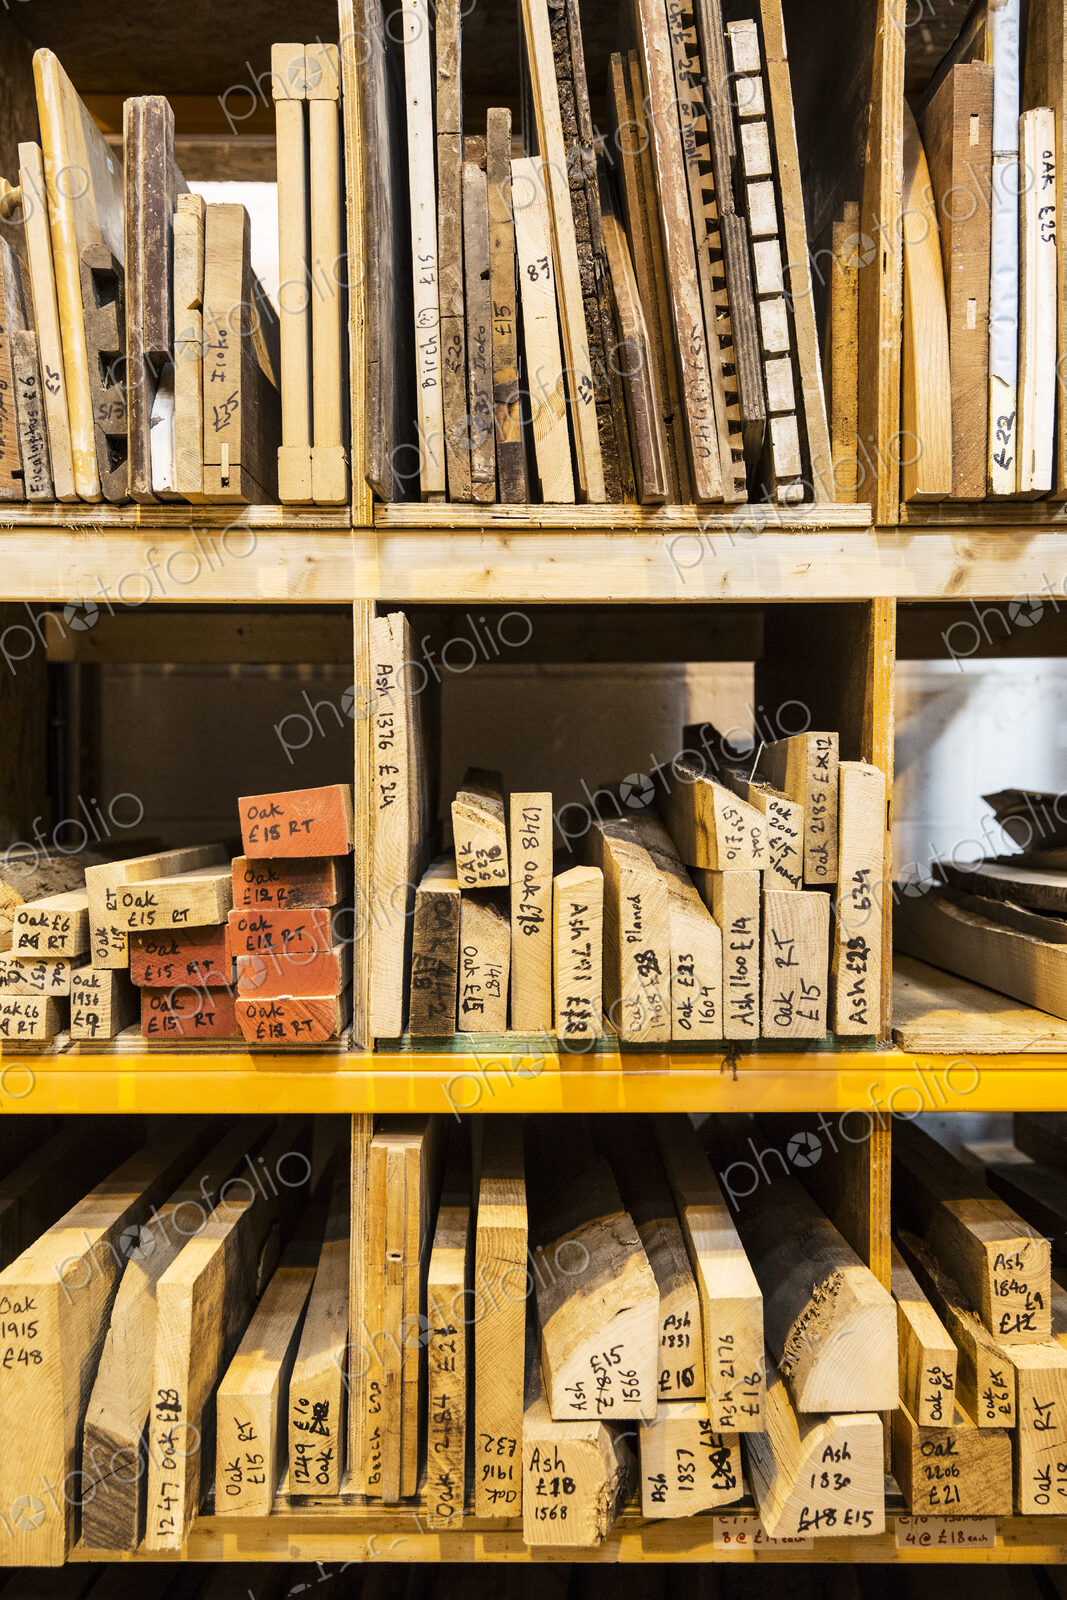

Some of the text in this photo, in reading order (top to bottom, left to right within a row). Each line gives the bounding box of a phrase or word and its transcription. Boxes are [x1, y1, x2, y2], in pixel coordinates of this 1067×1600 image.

[1042, 150, 1055, 190] OAK
[493, 304, 512, 336] £15
[421, 334, 437, 389] Birch
[376, 663, 395, 697] Ash
[377, 712, 395, 750] 1376
[248, 803, 284, 820] Oak
[289, 819, 315, 835] RT
[519, 807, 542, 850] 1248
[810, 793, 828, 876] Oak 2185
[750, 827, 764, 858] Oak
[244, 870, 280, 884] Oak
[522, 861, 542, 902] Oak
[106, 888, 117, 910] RT
[122, 891, 158, 908] Oak
[18, 912, 70, 931] Oak £6
[128, 909, 190, 927] £15 RT
[238, 916, 273, 932] Oak
[570, 903, 589, 940] Ash
[48, 934, 68, 949] RT
[282, 926, 305, 943] RT
[145, 941, 181, 956] Oak
[463, 946, 478, 978] Oak
[30, 960, 48, 990] 1937
[73, 975, 101, 988] Oak
[485, 963, 502, 997] 1487
[24, 1005, 40, 1019] £6
[72, 992, 99, 1007] 1936
[150, 996, 184, 1011] Oak
[247, 1005, 285, 1018] Oak
[700, 986, 715, 1024] 1604
[730, 992, 754, 1026] Ash
[773, 990, 795, 1027] Oak
[796, 978, 821, 1021] £15
[846, 978, 868, 1025] Ash
[148, 1012, 215, 1033] £15 RT
[292, 1019, 313, 1034] RT
[678, 997, 693, 1030] Oak
[18, 1021, 37, 1034] RT
[993, 1253, 1024, 1271] Ash
[994, 1279, 1028, 1297] 1840
[1, 1320, 39, 1339] 1915
[664, 1312, 690, 1330] Ash
[663, 1334, 690, 1348] 1831
[2, 1350, 44, 1370] £48
[618, 1370, 641, 1402] 1566
[718, 1335, 737, 1427] Ash 2176
[741, 1371, 761, 1416] £18
[926, 1366, 942, 1420] Oak £6
[566, 1381, 587, 1410] Ash
[1033, 1397, 1057, 1431] RT
[530, 1446, 565, 1473] Ash
[822, 1442, 851, 1462] Ash
[921, 1437, 959, 1456] Oak
[225, 1457, 243, 1496] Oak
[247, 1453, 266, 1484] £15
[295, 1444, 315, 1484] 1249
[315, 1448, 334, 1485] Oak
[482, 1465, 513, 1481] 1916
[677, 1449, 695, 1491] 1837
[924, 1466, 960, 1480] 2206
[436, 1472, 455, 1518] Oak
[485, 1488, 517, 1503] Oak
[648, 1474, 668, 1502] Ash
[929, 1485, 960, 1505] £21
[1034, 1464, 1051, 1505] Oak
[156, 1482, 181, 1536] 1247
[535, 1506, 568, 1520] 1568
[844, 1509, 873, 1528] £15
[906, 1532, 916, 1545] 4
[919, 1533, 932, 1546] @
[938, 1530, 965, 1544] £18
